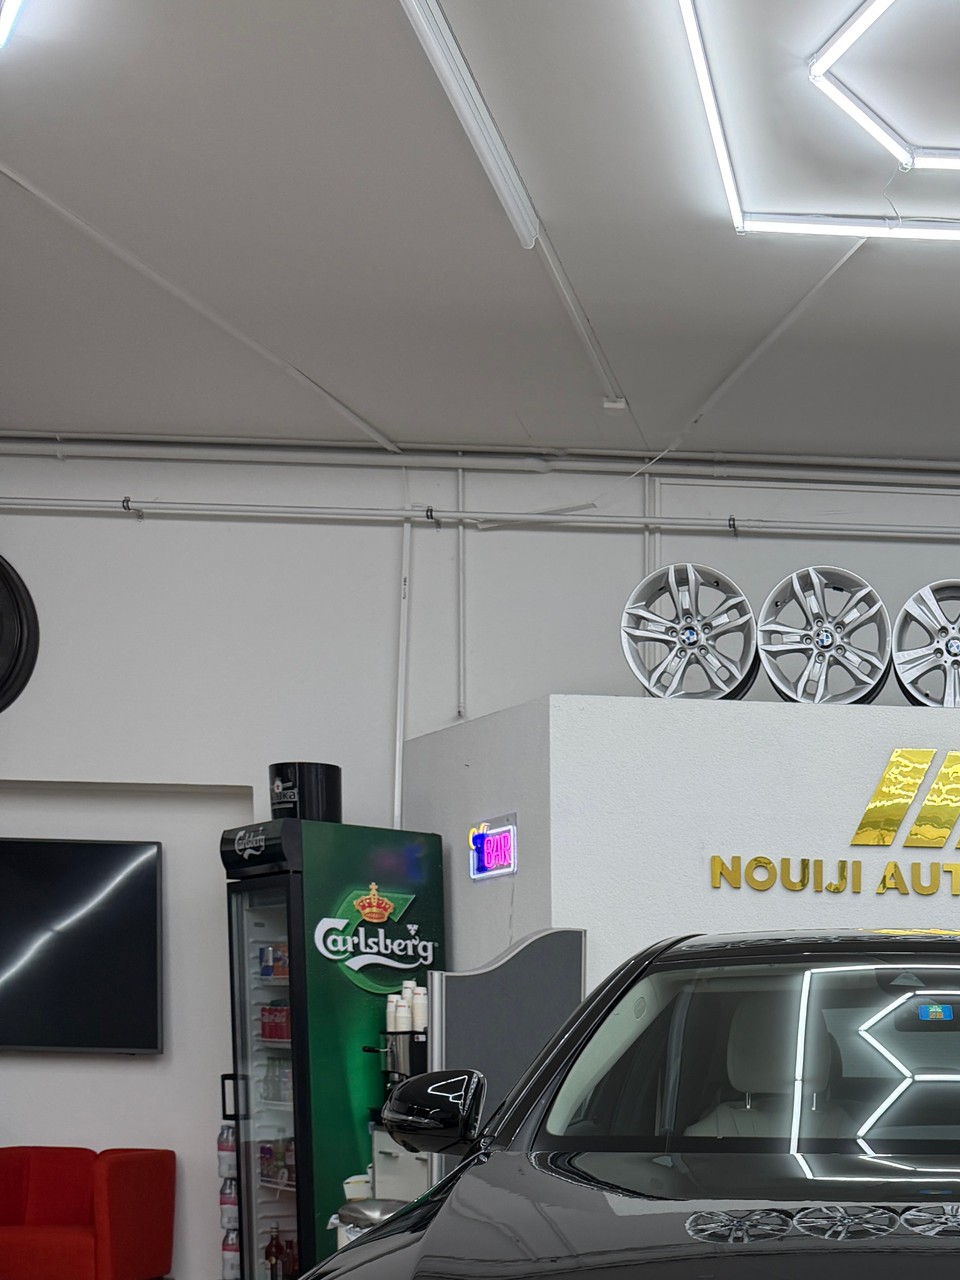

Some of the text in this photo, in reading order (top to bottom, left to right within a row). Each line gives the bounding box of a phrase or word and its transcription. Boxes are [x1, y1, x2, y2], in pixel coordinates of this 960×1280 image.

[484, 832, 512, 868] BAR
[711, 855, 862, 894] NOUIJI
[314, 917, 434, 969] Carlsberg
